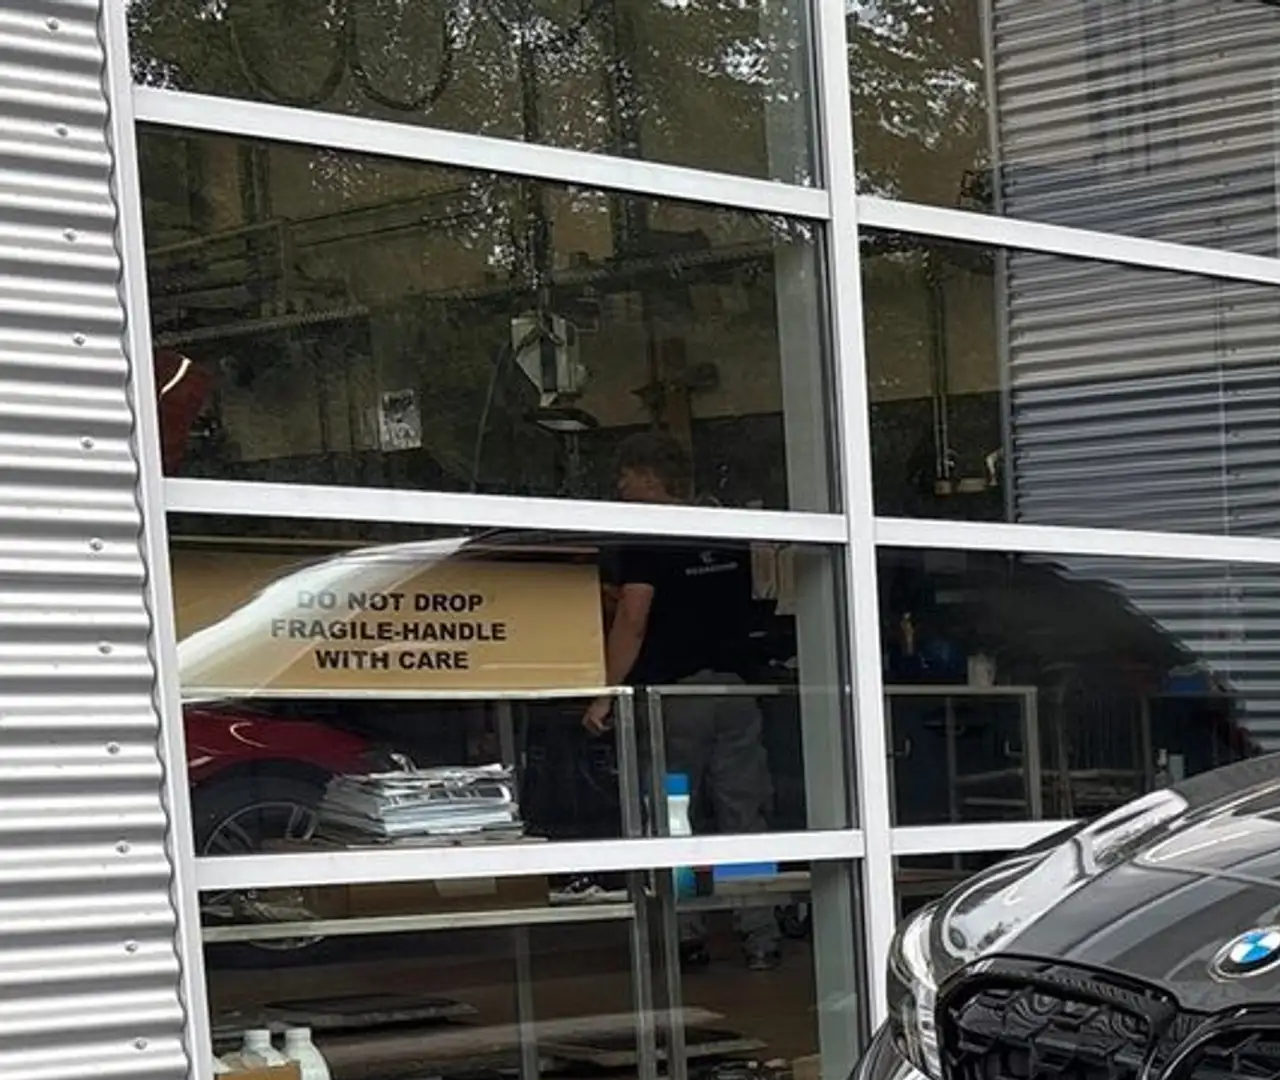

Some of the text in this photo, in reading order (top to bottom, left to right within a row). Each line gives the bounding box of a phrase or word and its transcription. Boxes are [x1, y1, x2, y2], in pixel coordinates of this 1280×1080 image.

[298, 590, 484, 612] DO NOT DROP
[271, 618, 507, 642] FRAGILE-HANDLE
[315, 650, 469, 669] WITH CARE
